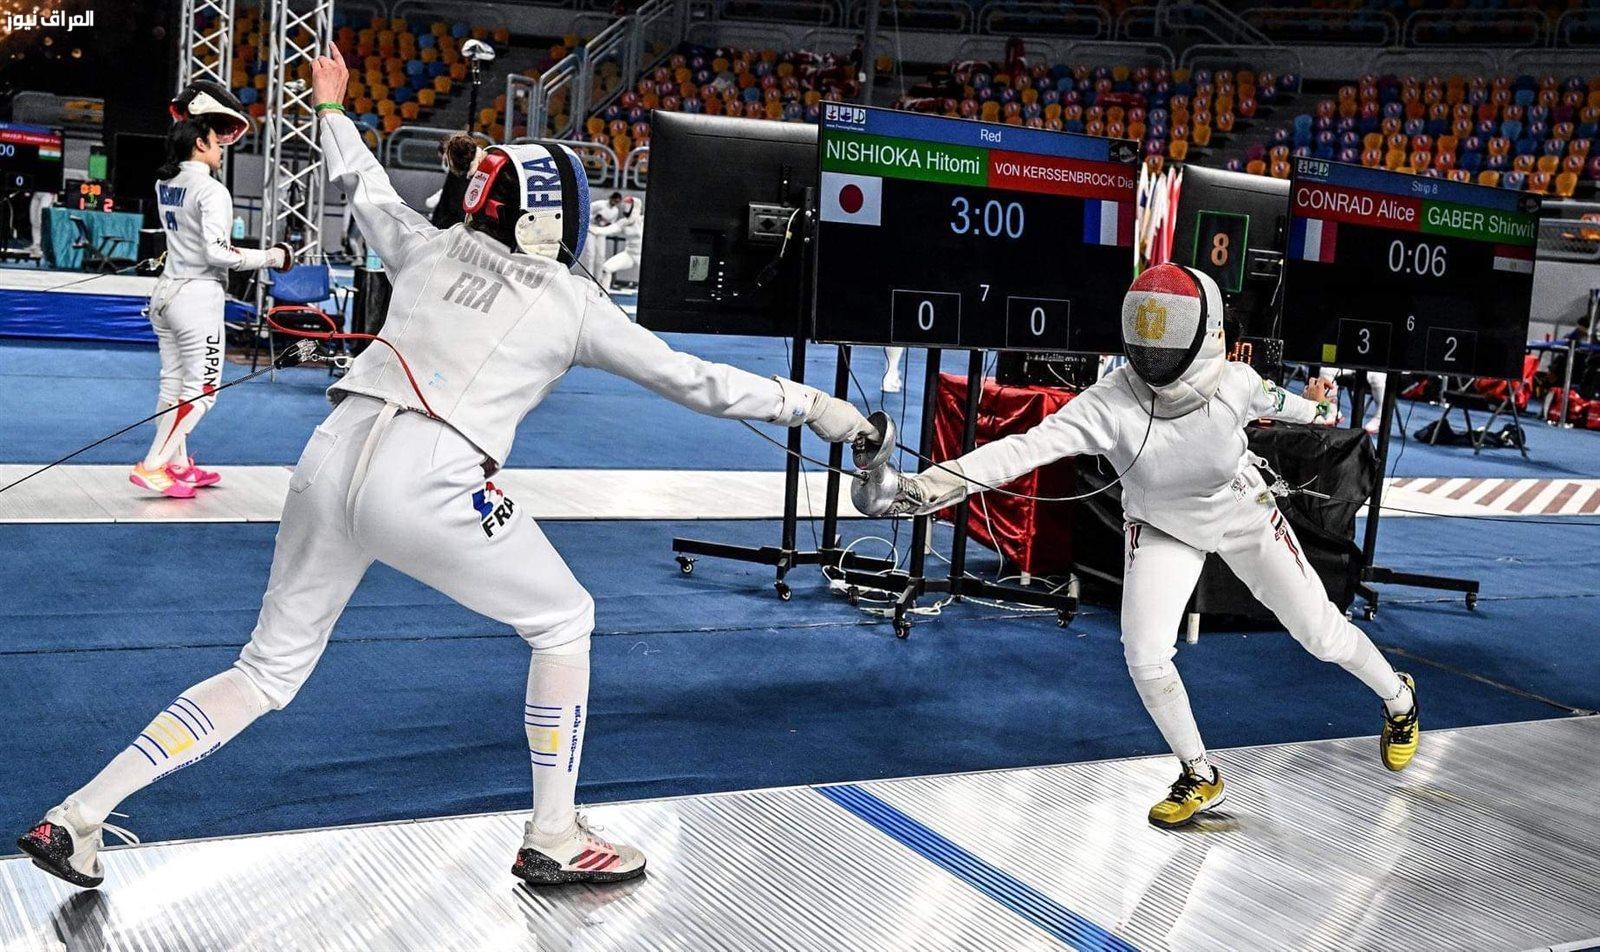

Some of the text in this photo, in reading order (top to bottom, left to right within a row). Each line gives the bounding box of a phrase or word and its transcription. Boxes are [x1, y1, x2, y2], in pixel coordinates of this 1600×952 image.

[980, 129, 1001, 143] Red
[826, 139, 980, 175] NISHIOKA Hitomi
[16, 176, 24, 186] 0
[521, 156, 562, 208] FRA
[994, 162, 1020, 177] VON
[1023, 165, 1115, 187] KERSSENBROCK
[1411, 180, 1431, 195] Strip
[103, 198, 114, 212] 2
[950, 196, 1024, 239] 3:00
[1296, 187, 1415, 222] CONRAD Alice
[1427, 206, 1535, 239] GABER Shirwit
[1210, 232, 1230, 267] 8
[1388, 239, 1447, 277] 0:06
[442, 271, 503, 314] FRA
[979, 283, 990, 302] 7
[918, 300, 935, 331] 0
[1030, 306, 1046, 336] 0
[1406, 315, 1416, 331] 6
[1357, 328, 1371, 354] 3
[1443, 336, 1458, 362] 2
[203, 335, 220, 388] JAPAN
[482, 496, 515, 538] FRA
